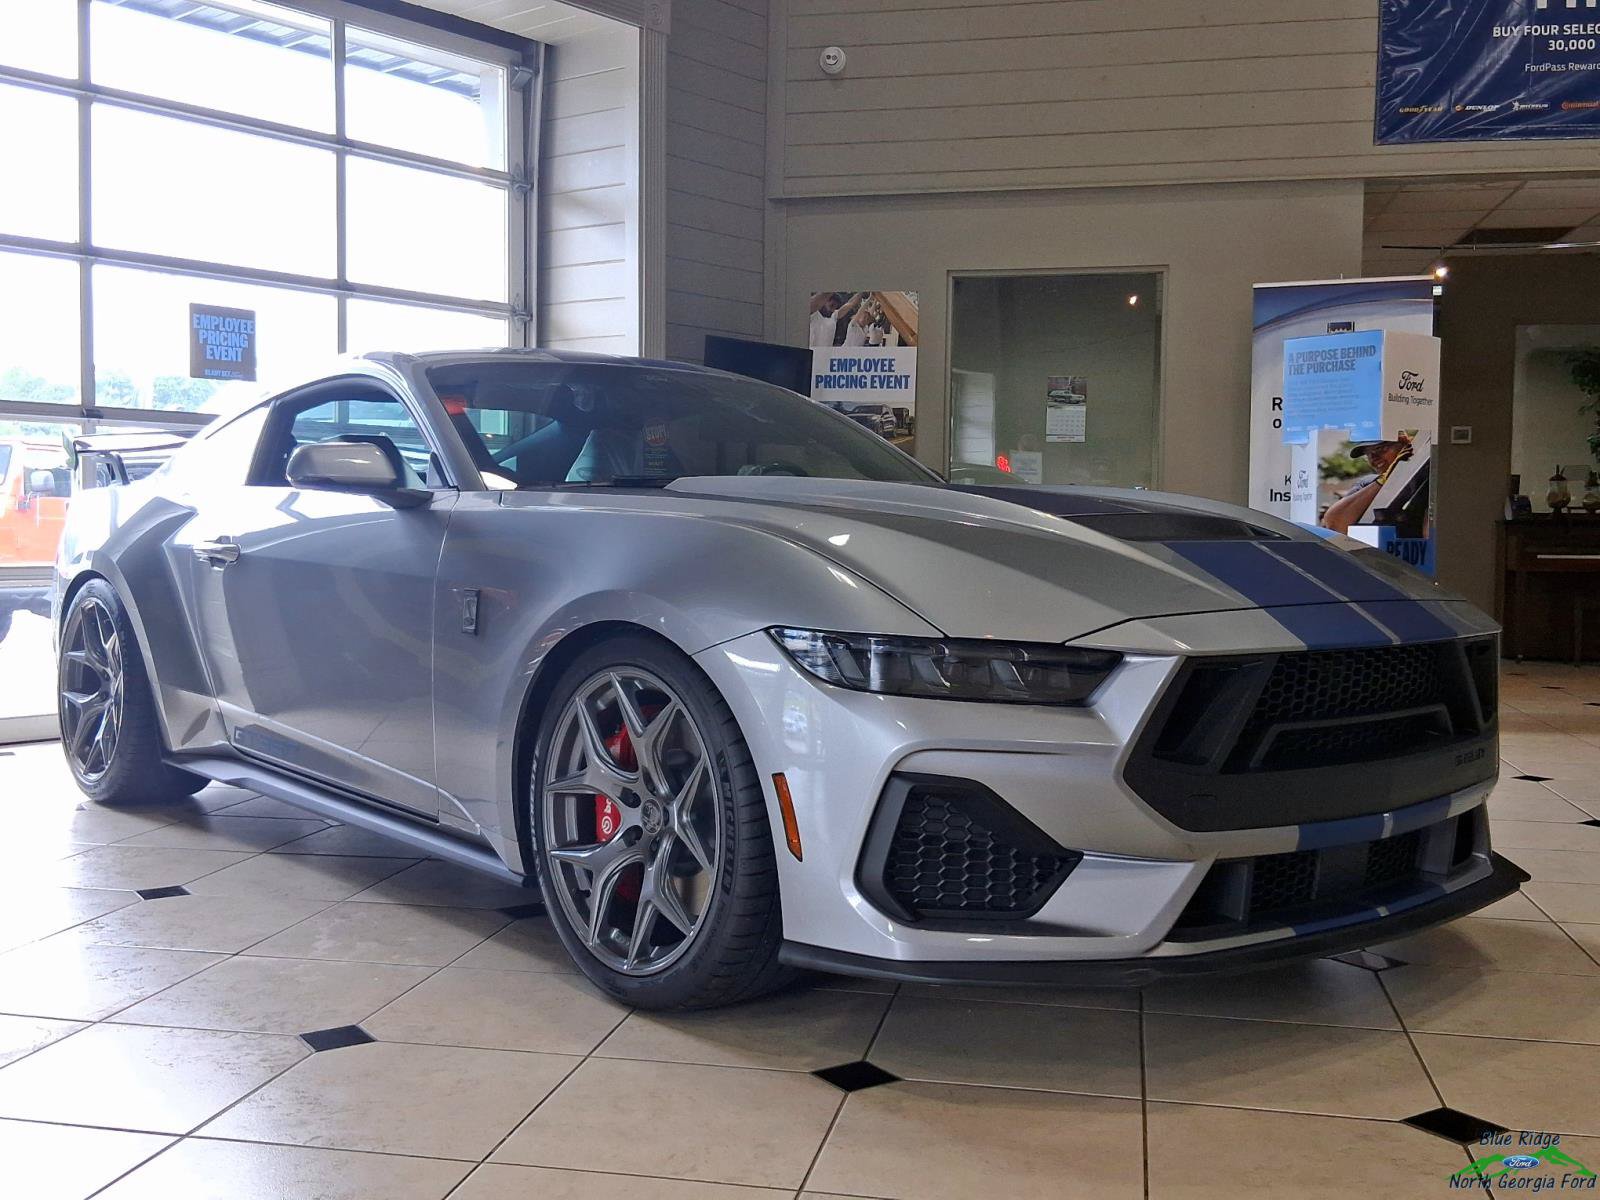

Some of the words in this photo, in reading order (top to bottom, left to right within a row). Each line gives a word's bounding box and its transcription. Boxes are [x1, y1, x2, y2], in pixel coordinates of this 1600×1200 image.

[1493, 26, 1522, 37] BUY
[1524, 26, 1560, 36] FOUR
[1548, 39, 1596, 52] 30,000
[1525, 62, 1566, 72] FordPass
[192, 313, 254, 334] EMPLOYEE
[199, 330, 248, 348] PRICING
[206, 345, 242, 361] EVENT
[1288, 352, 1295, 364] A
[1296, 347, 1339, 362] PURPOSE
[1340, 345, 1376, 360] BEHIND
[830, 358, 896, 372] EMPLOYEE
[1288, 362, 1306, 376] THE
[1306, 358, 1356, 374] PURCHASE
[815, 374, 868, 389] PRICING
[870, 374, 910, 390] EVENT
[1398, 370, 1424, 392] Ford
[722, 782, 736, 889] MICHELIN
